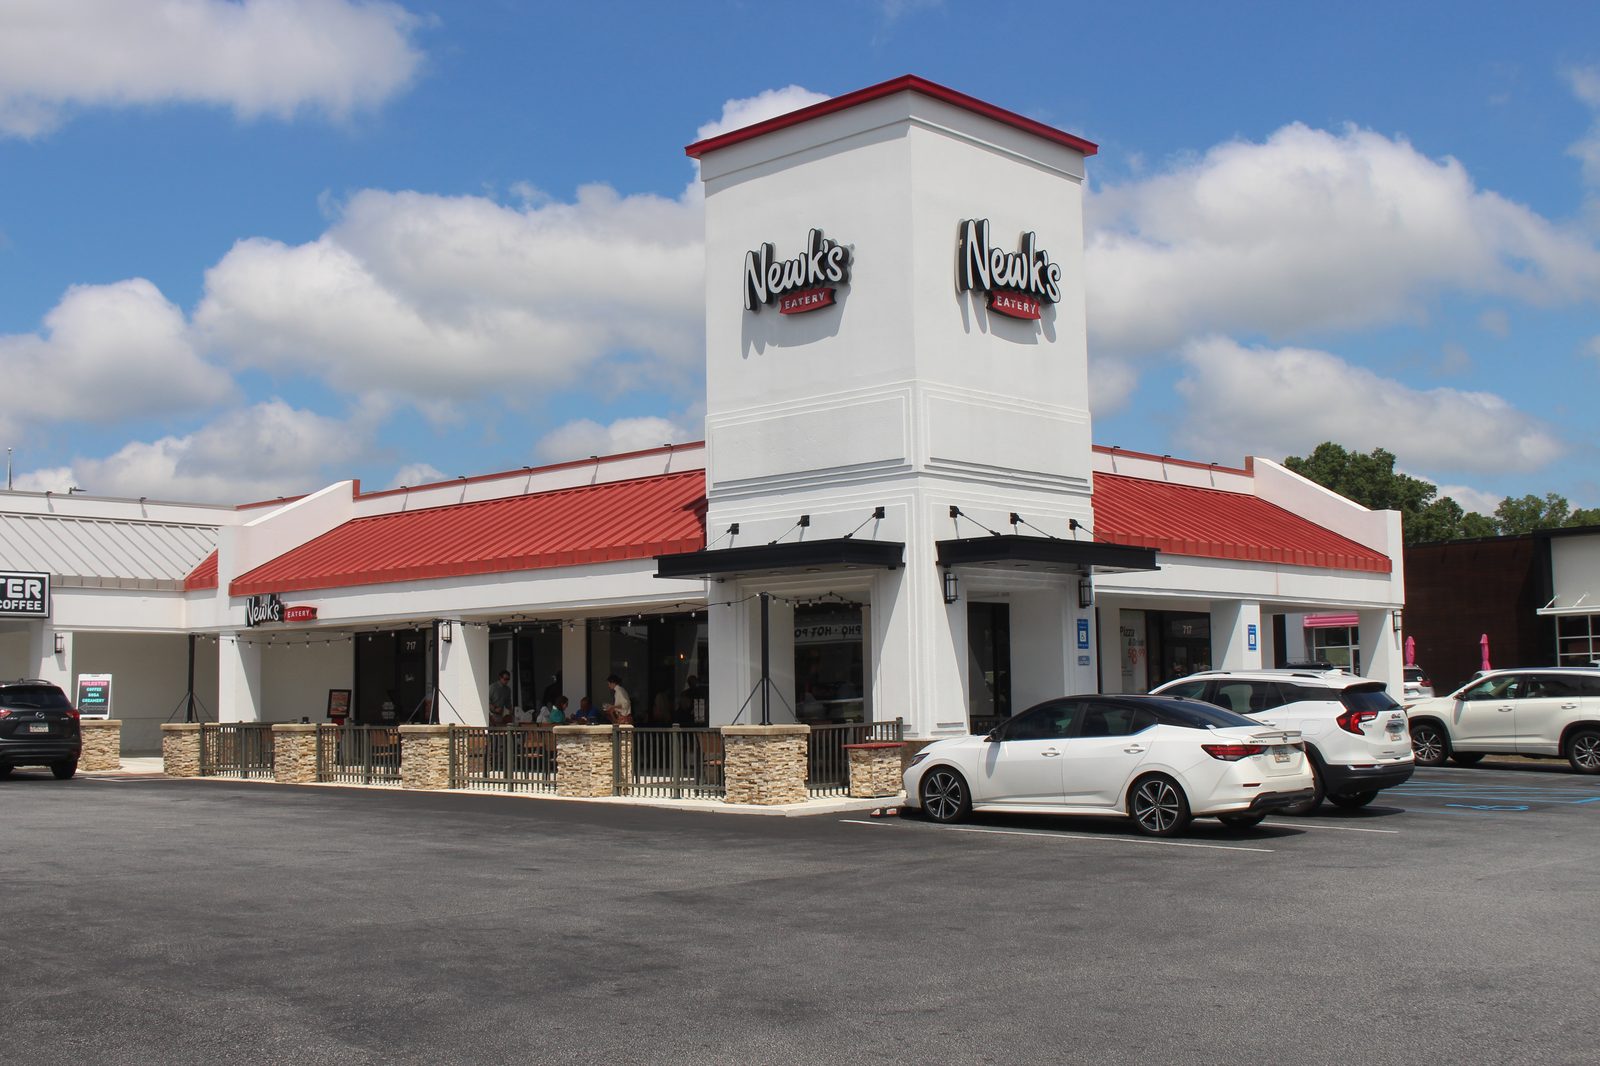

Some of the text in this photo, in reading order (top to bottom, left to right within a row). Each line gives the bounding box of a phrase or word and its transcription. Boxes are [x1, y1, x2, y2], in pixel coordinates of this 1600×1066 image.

[743, 228, 846, 311] Newk's
[965, 218, 1062, 304] Newk's
[784, 292, 825, 310] EATERY
[996, 295, 1036, 314] EATERY
[0, 599, 42, 611] OFFEE
[245, 594, 280, 627] Newk's
[287, 609, 310, 619] EATERY
[406, 641, 417, 650] 717
